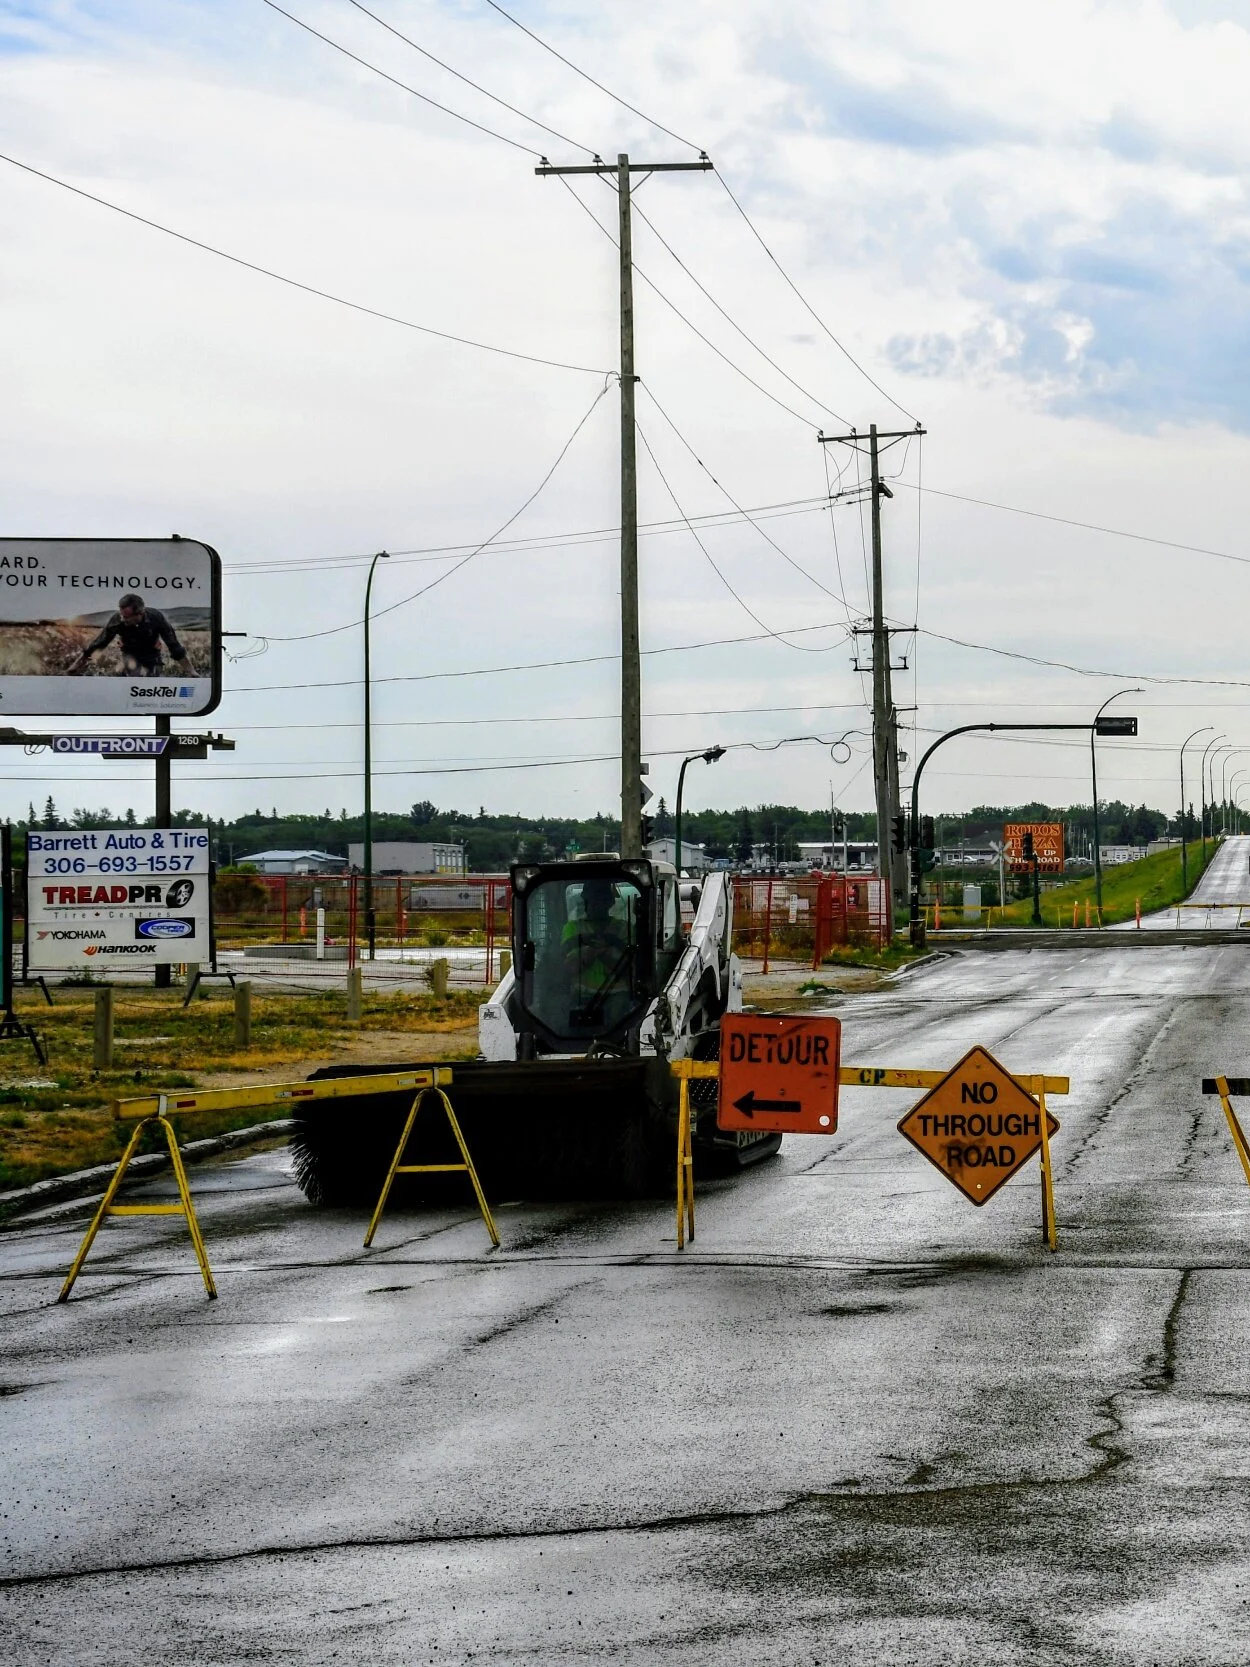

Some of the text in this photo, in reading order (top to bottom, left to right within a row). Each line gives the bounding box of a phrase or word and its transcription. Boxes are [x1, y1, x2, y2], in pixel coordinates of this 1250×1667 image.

[57, 575, 201, 589] TECHNOLOGY.
[130, 686, 177, 698] SaskTel
[56, 737, 163, 752] OUTFRONT
[178, 736, 199, 745] 1260
[28, 833, 209, 851] Barrett Auto & Tire
[1010, 837, 1058, 849] PIZA
[44, 856, 194, 873] 306-693-1557
[109, 911, 171, 919] Centres
[51, 930, 106, 940] YOKOHAMA
[730, 1032, 829, 1065] DETOUR
[860, 1069, 885, 1084] CP
[961, 1082, 998, 1104] NO
[917, 1114, 1039, 1137] THROUGH
[946, 1146, 1016, 1168] ROAD
